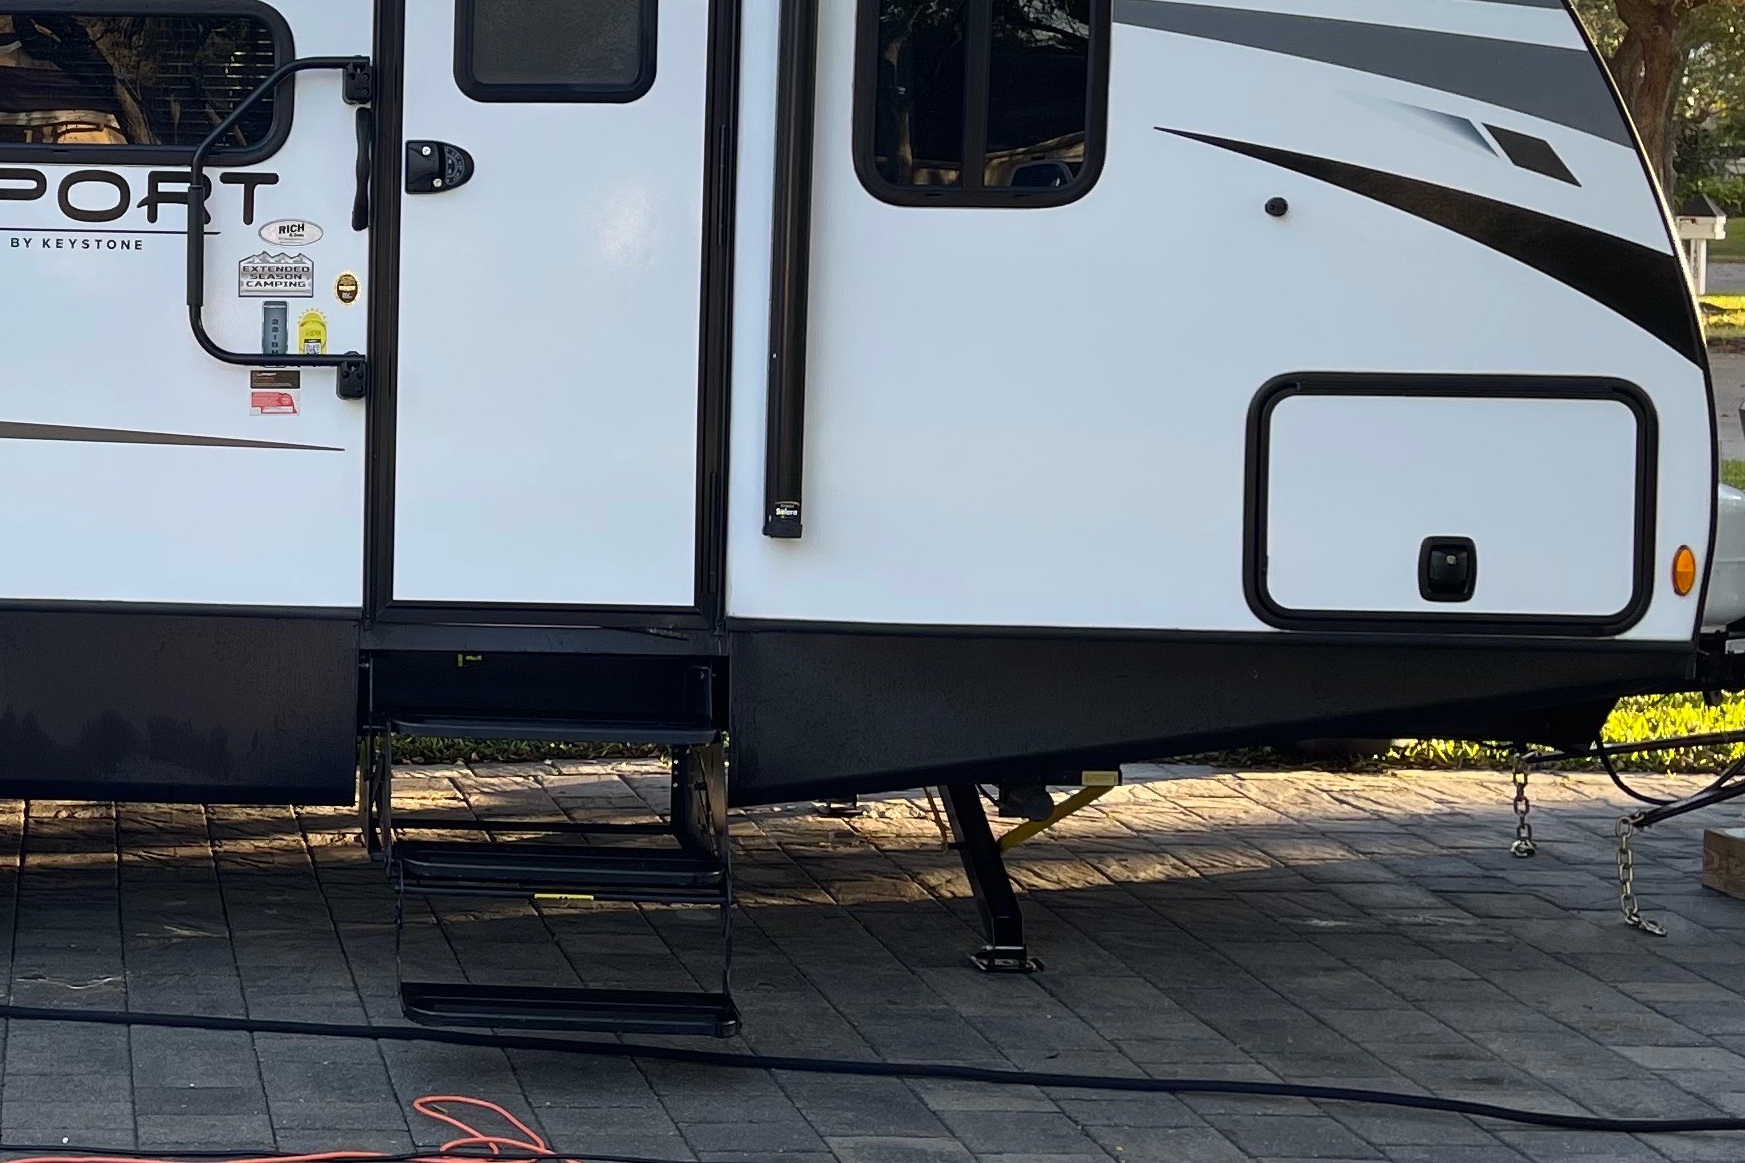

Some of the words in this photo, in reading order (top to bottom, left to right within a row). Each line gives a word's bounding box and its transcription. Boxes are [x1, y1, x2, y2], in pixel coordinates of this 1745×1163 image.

[278, 223, 305, 235] RICH
[10, 237, 33, 249] BY
[41, 238, 144, 251] KEYSTONE
[242, 265, 310, 273] EXTENDED
[246, 280, 307, 288] CAMPING
